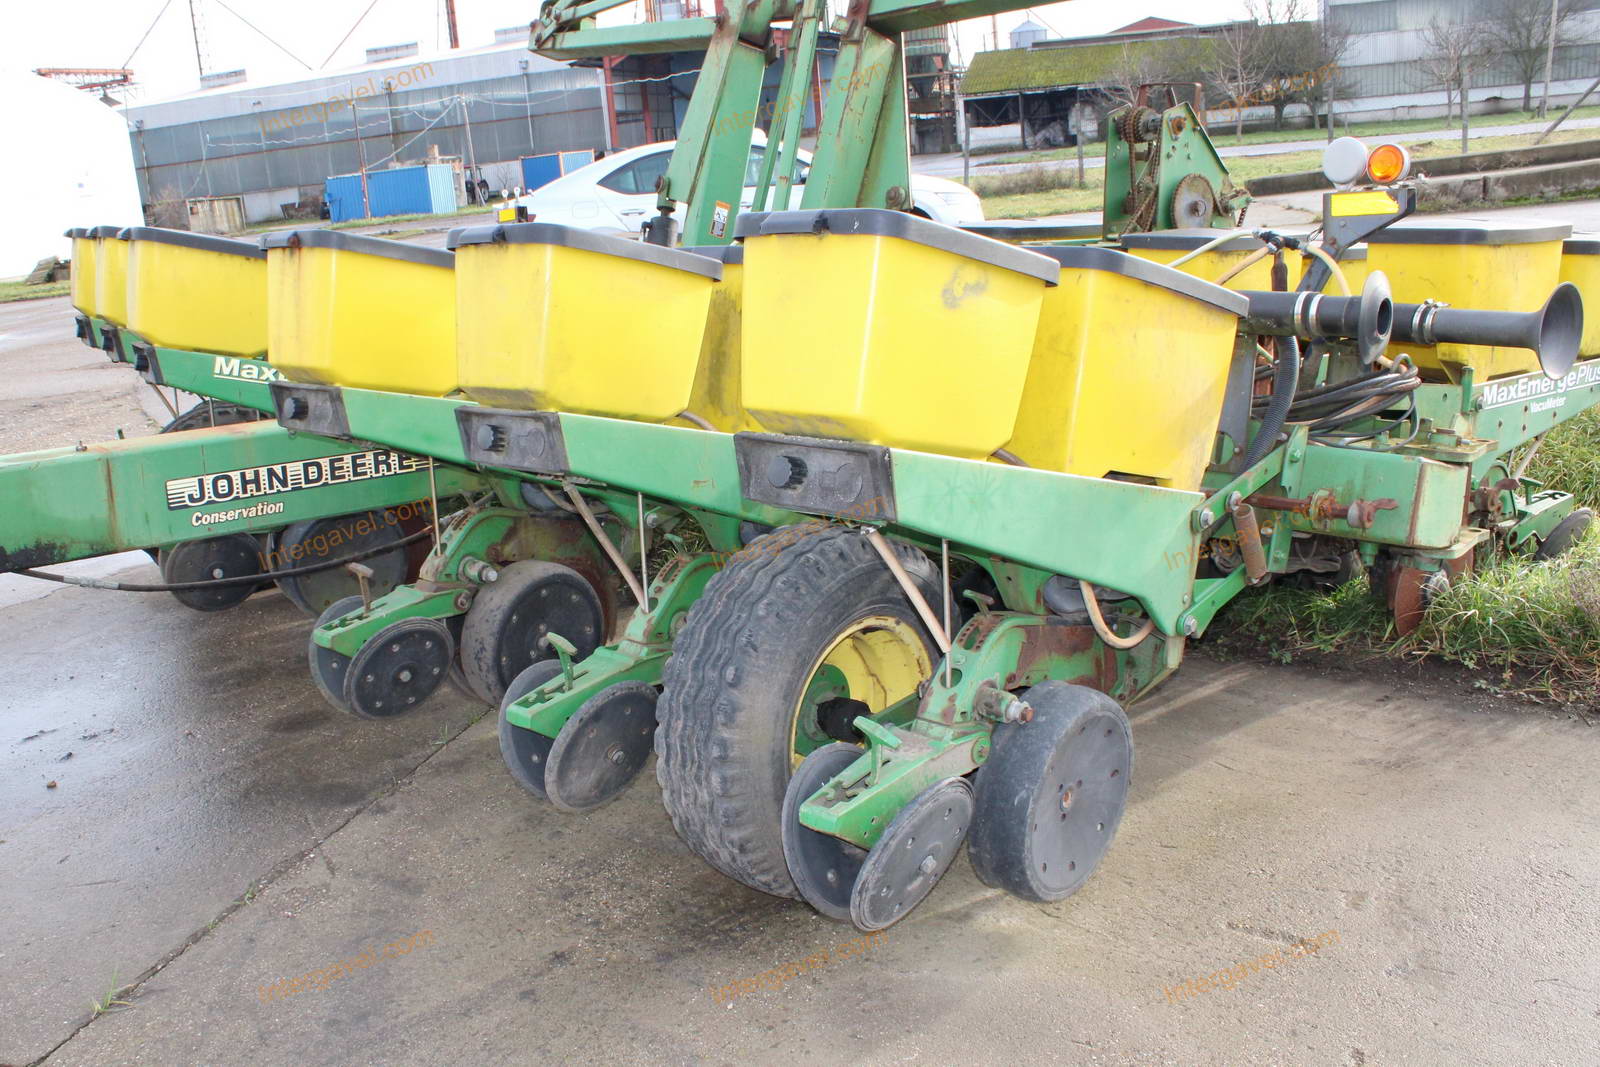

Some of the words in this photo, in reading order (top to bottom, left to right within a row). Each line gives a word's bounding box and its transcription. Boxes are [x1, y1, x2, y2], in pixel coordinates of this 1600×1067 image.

[184, 464, 293, 506] JOHN
[299, 449, 417, 490] DEERE
[191, 500, 284, 527] Conservation
